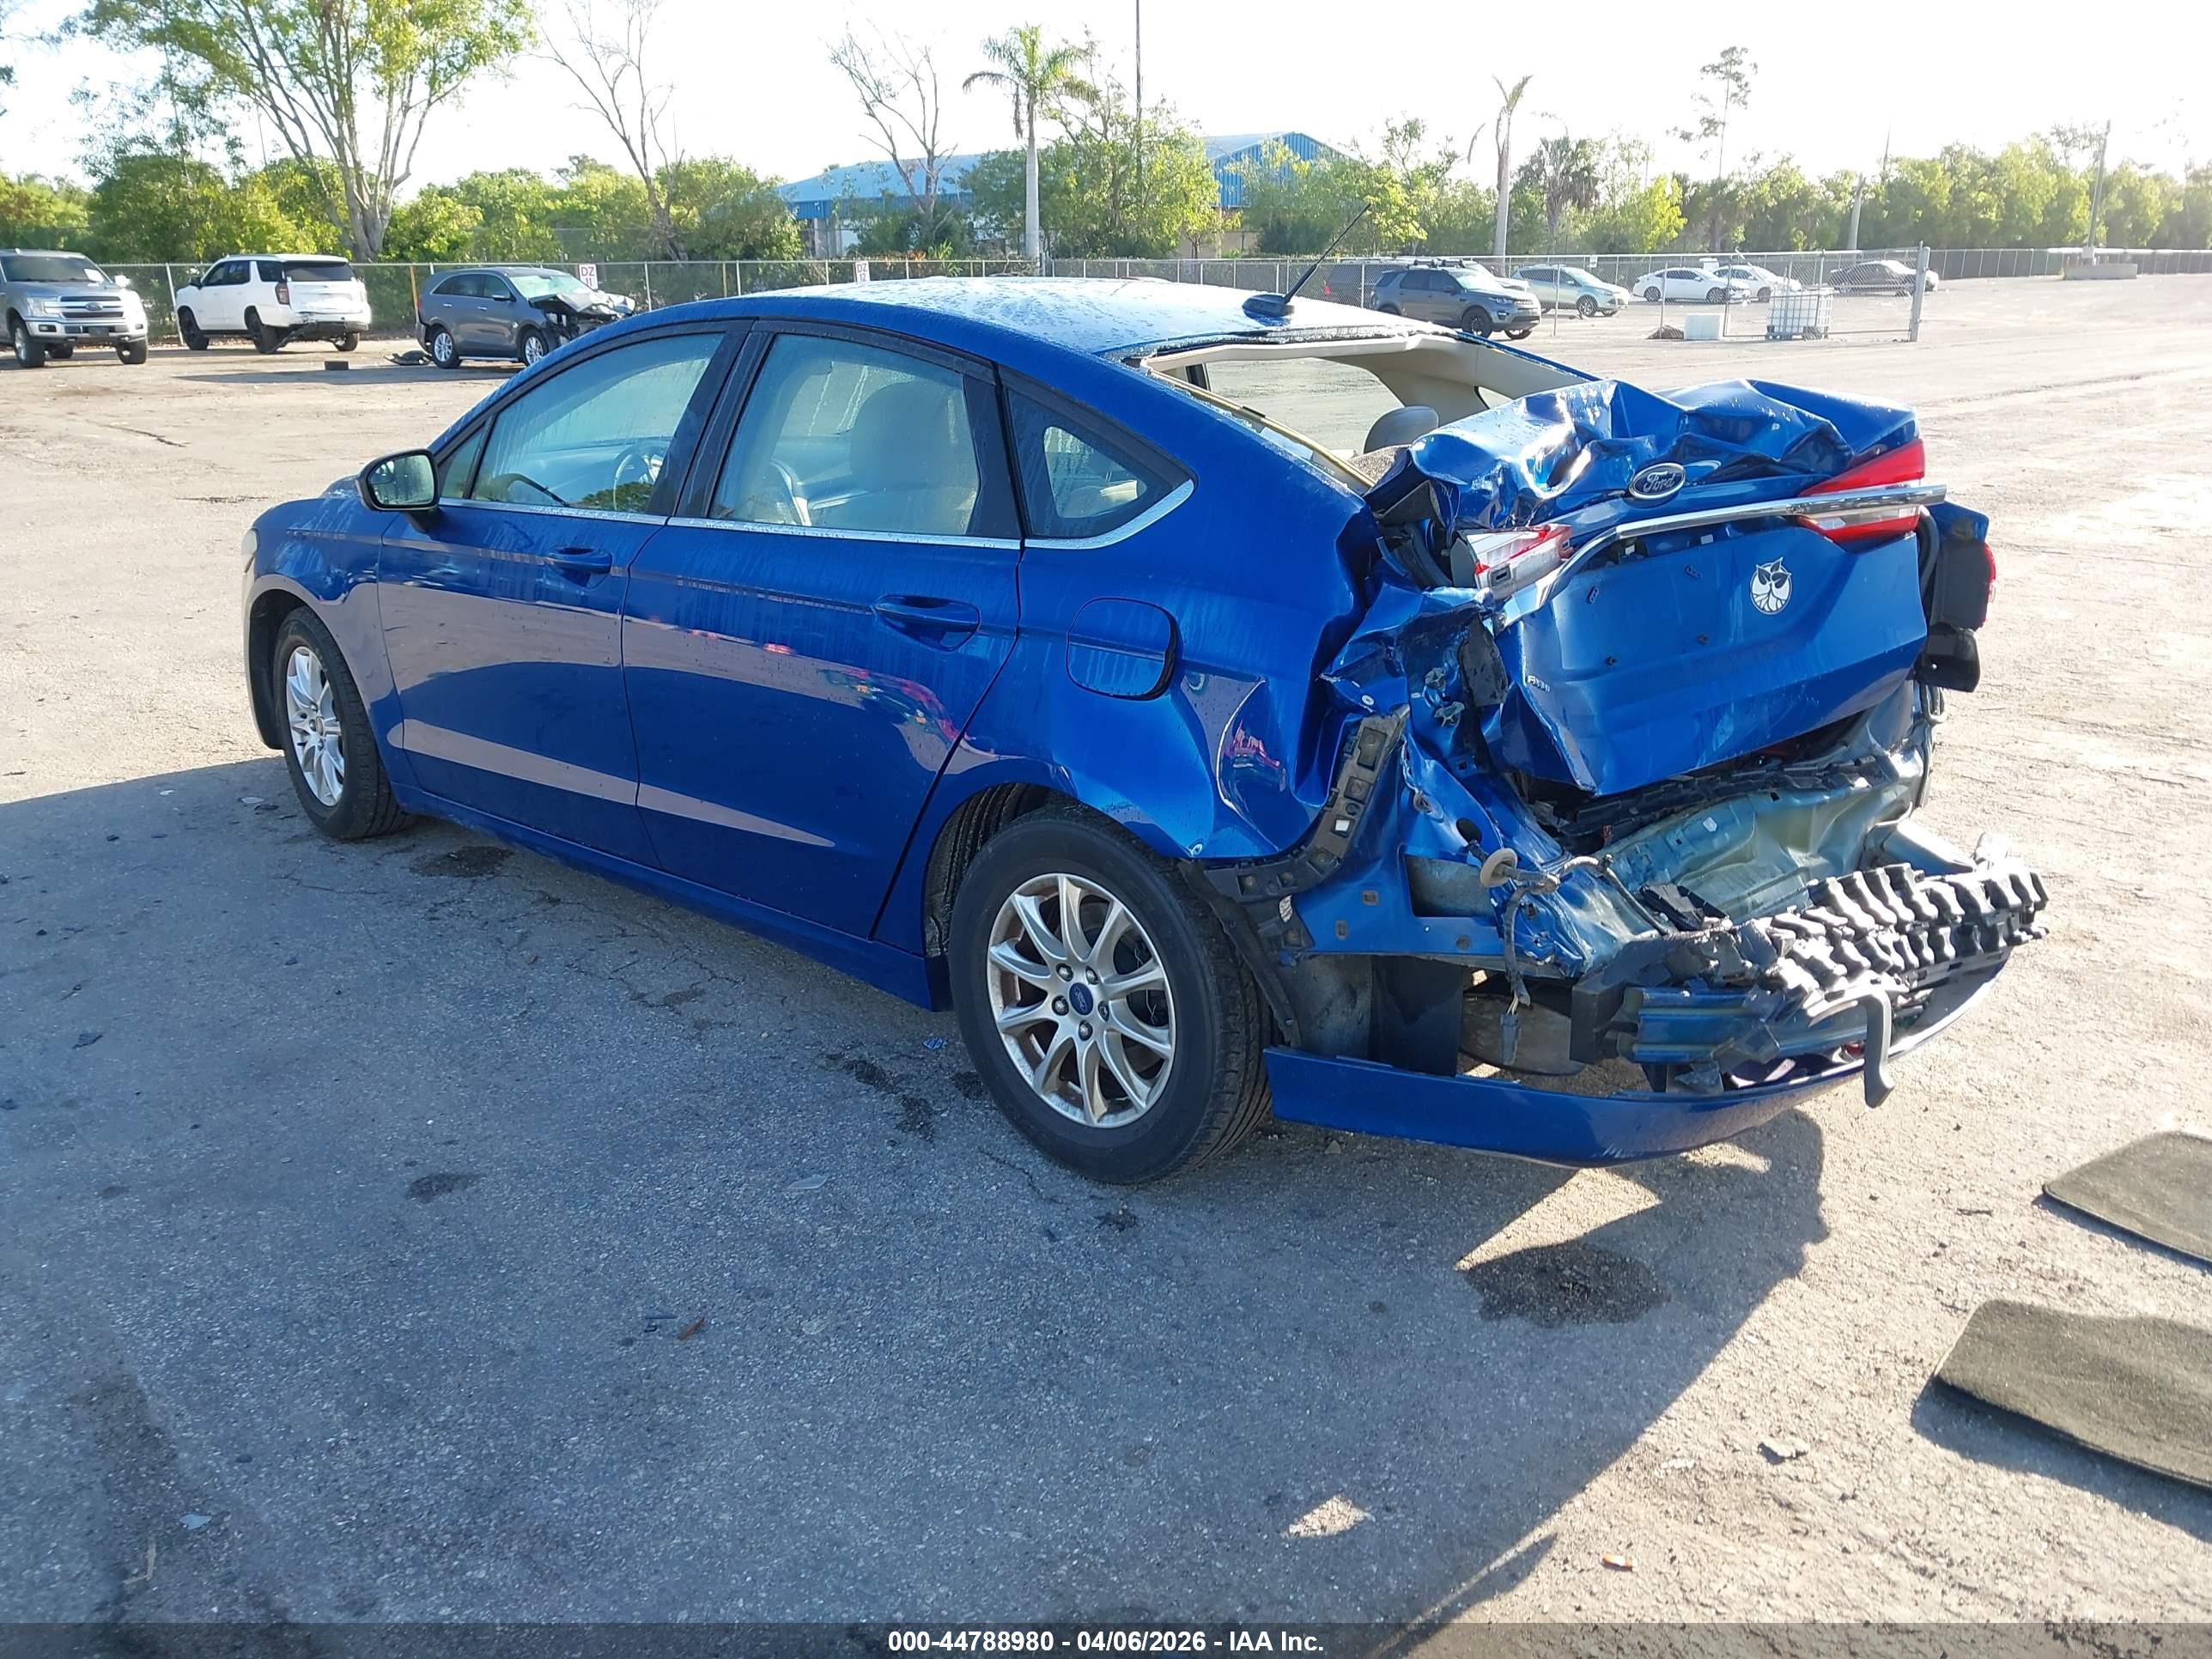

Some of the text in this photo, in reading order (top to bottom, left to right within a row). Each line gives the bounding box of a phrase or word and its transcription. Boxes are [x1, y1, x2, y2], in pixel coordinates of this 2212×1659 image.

[581, 266, 595, 276] DZ
[586, 277, 592, 288] 11
[1643, 471, 1675, 493] Ford
